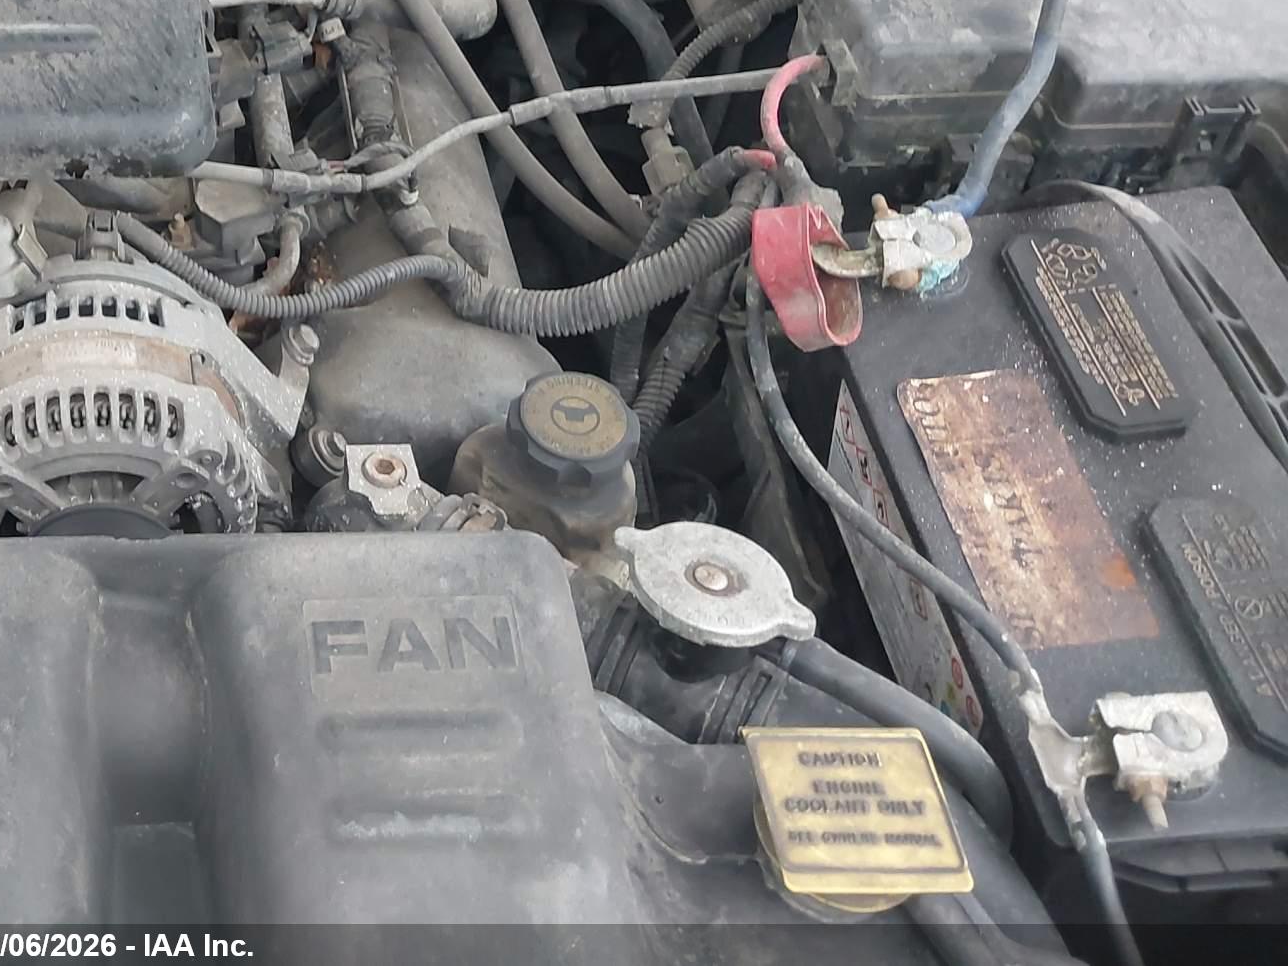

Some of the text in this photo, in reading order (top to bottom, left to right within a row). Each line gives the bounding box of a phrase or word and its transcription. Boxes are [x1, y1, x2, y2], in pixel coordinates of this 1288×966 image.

[311, 615, 520, 677] FAN
[797, 751, 883, 767] CAUTION
[811, 779, 886, 794] ENGINE
[784, 797, 869, 814] COOLANT
